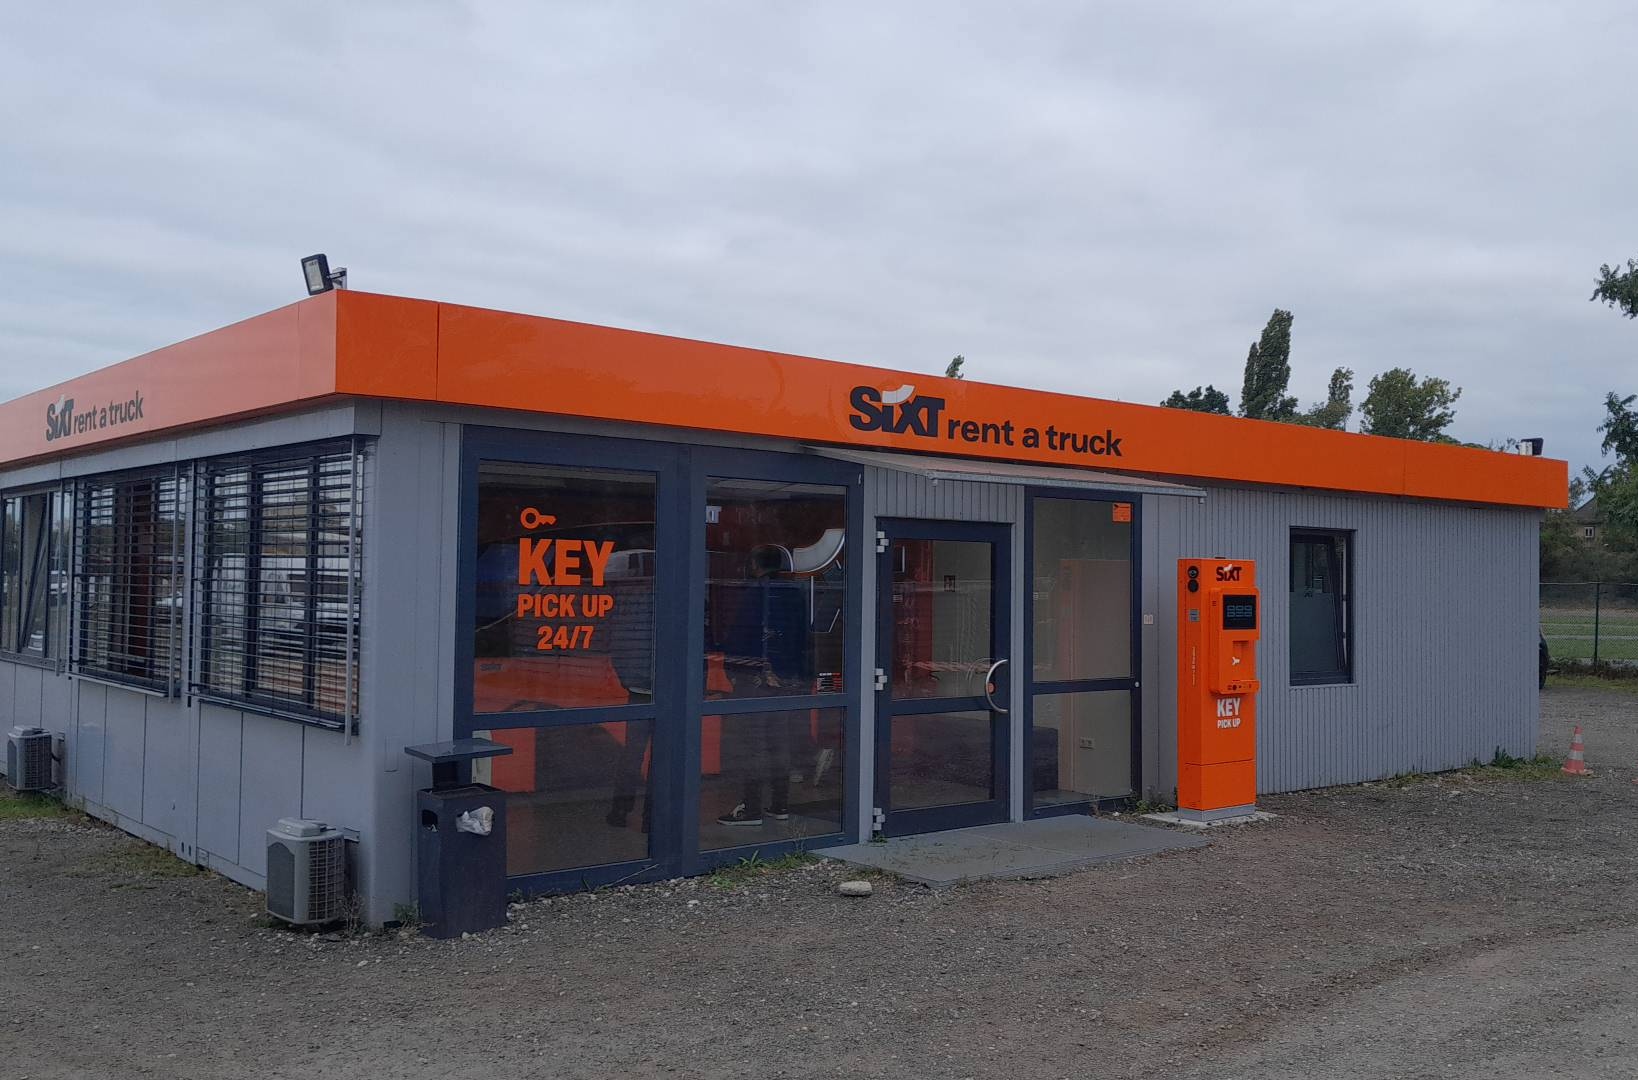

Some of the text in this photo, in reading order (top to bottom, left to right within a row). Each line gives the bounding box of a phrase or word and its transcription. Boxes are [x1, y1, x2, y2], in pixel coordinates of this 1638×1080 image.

[74, 405, 98, 434] rent
[100, 407, 107, 428] a
[109, 390, 144, 426] truck
[948, 419, 1014, 447] rent
[1022, 427, 1040, 448] a
[1046, 425, 1123, 456] truck
[518, 537, 616, 586] KEY
[517, 593, 614, 618] PICK UP
[537, 625, 594, 650] 24/7
[1217, 697, 1240, 717] KEY
[1217, 718, 1241, 729] PICK UP
